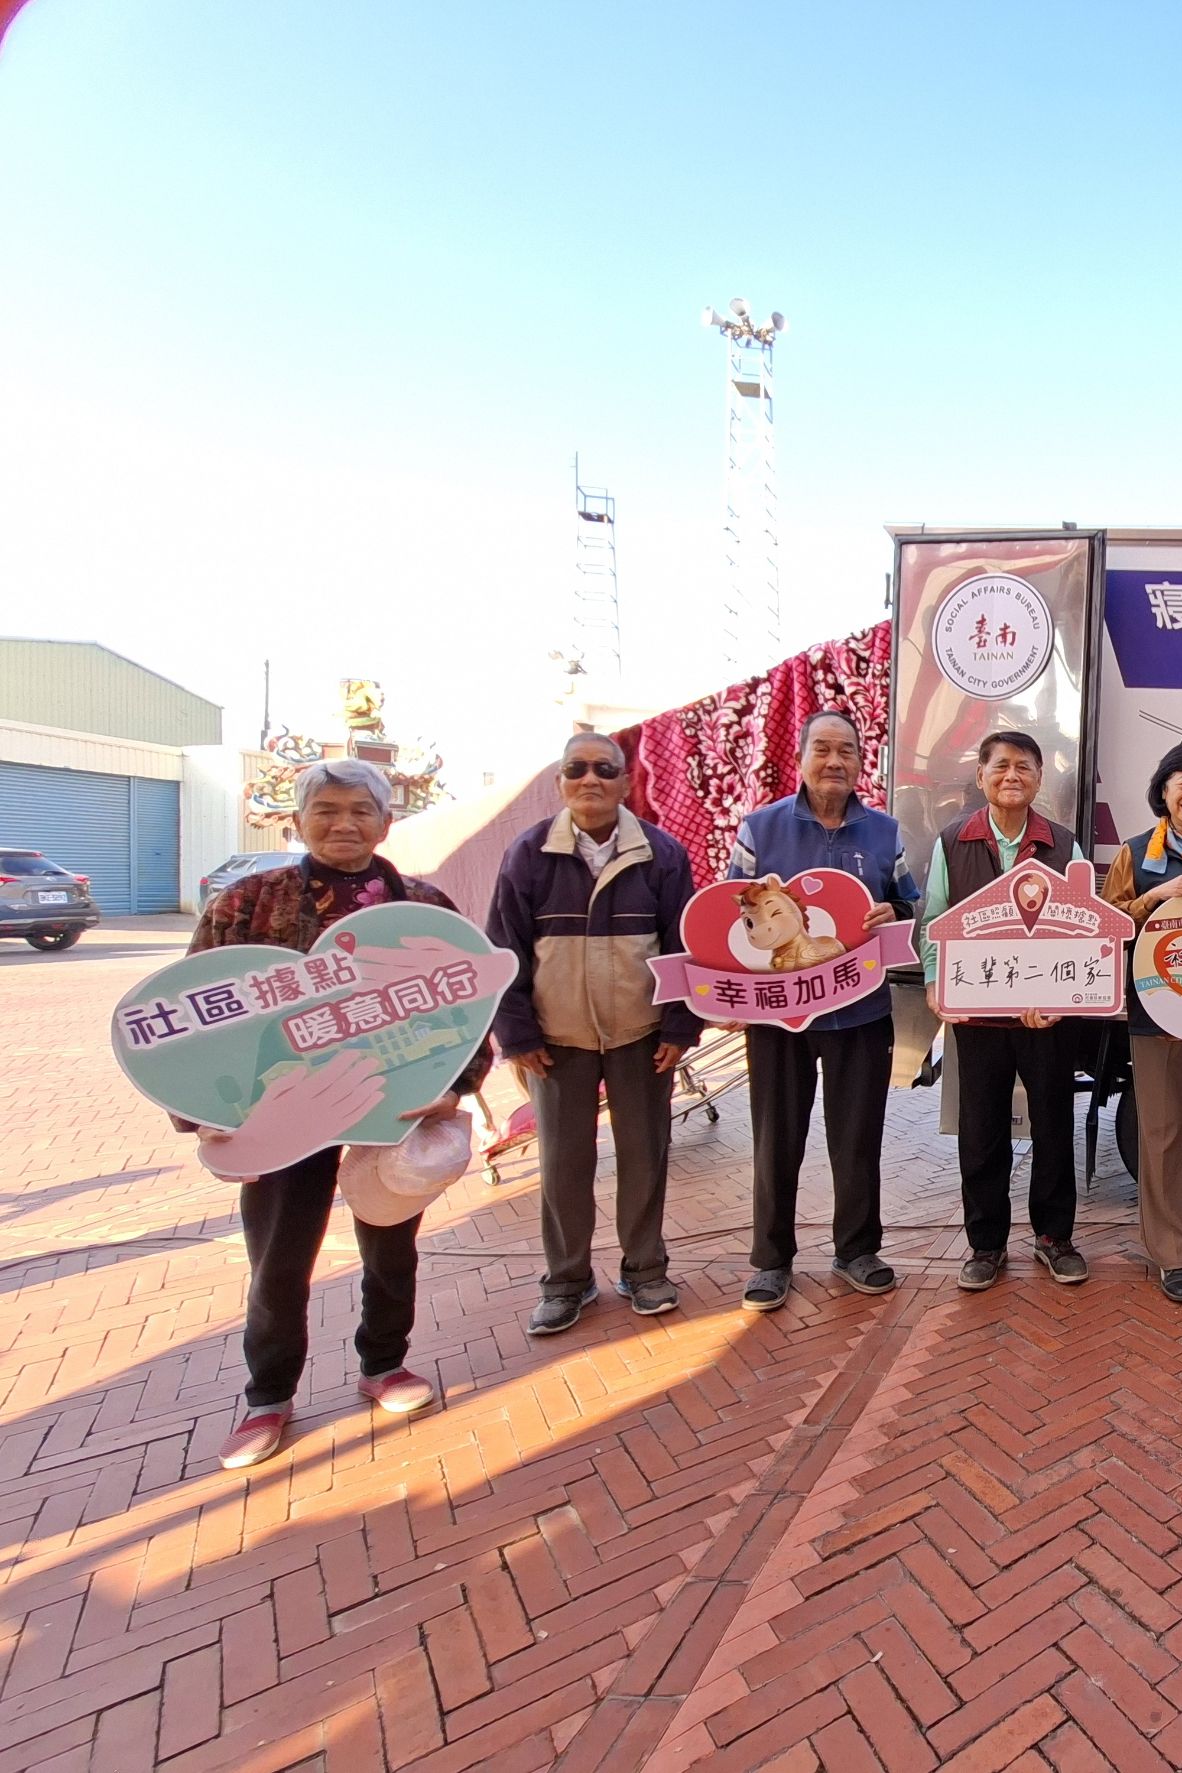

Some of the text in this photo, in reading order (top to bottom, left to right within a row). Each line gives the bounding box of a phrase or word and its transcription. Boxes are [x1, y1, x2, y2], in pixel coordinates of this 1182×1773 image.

[945, 586, 1040, 632] SOCIAL AFFAIRS BUREAU
[945, 645, 1039, 689] TAINAN CITY GOVERNMENT
[973, 652, 1014, 661] TAINAN
[713, 957, 861, 1010] 幸福加馬
[950, 956, 1112, 988] 長輩第二個家
[1141, 977, 1168, 989] TAINAN
[124, 950, 358, 1045] 社區據點
[287, 963, 478, 1049] 暖意同行
